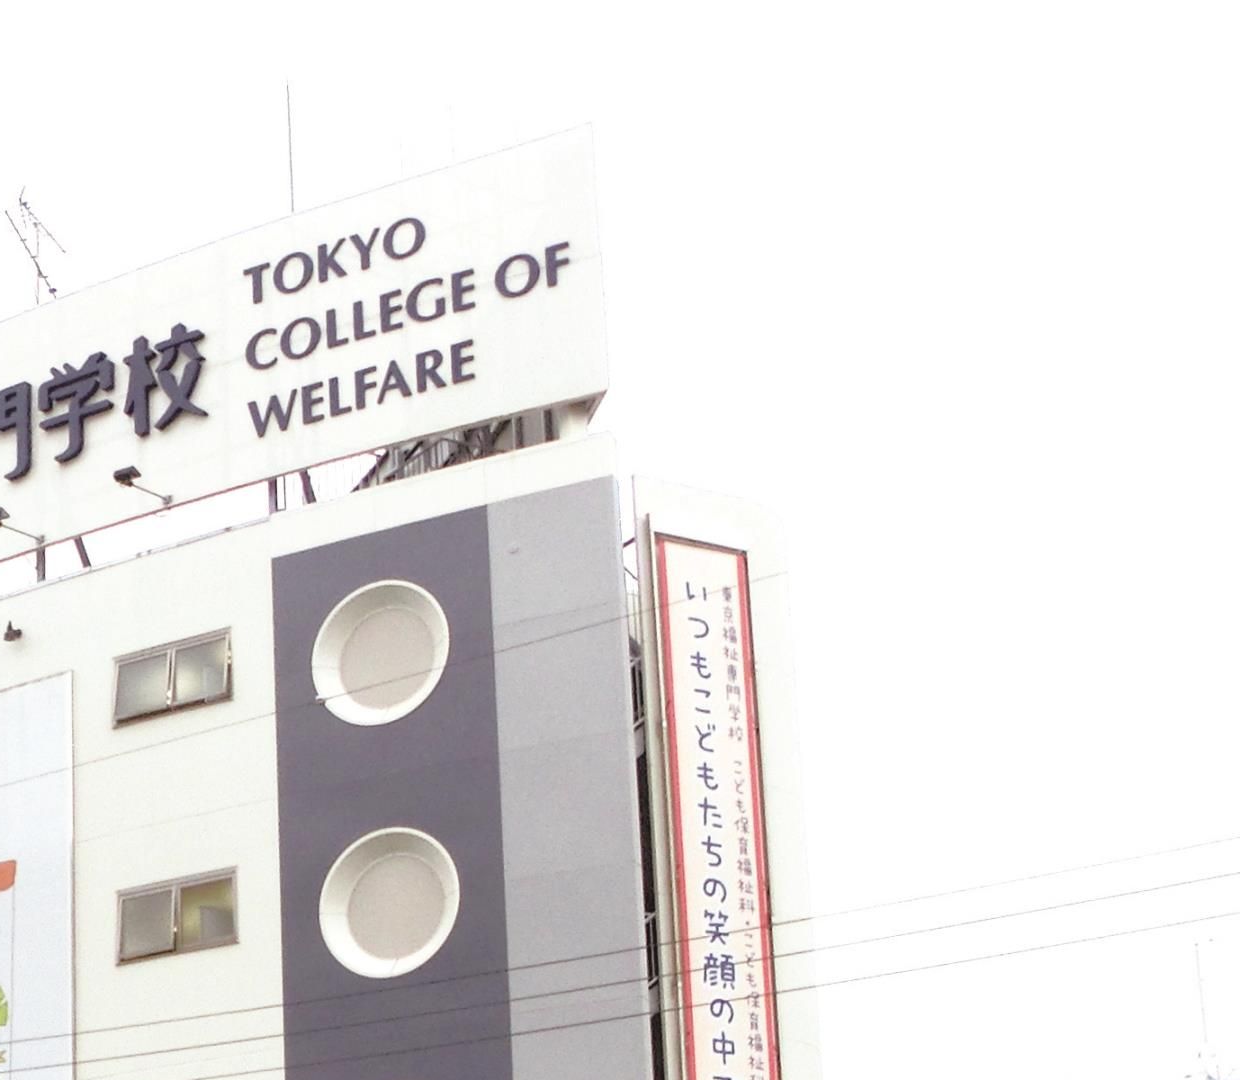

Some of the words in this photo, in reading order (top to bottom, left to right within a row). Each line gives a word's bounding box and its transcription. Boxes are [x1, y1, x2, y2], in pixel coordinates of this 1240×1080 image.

[243, 217, 426, 304] TOKYO
[245, 268, 476, 370] COLLEGE
[494, 241, 571, 298] OF
[247, 338, 476, 438] WELFARE
